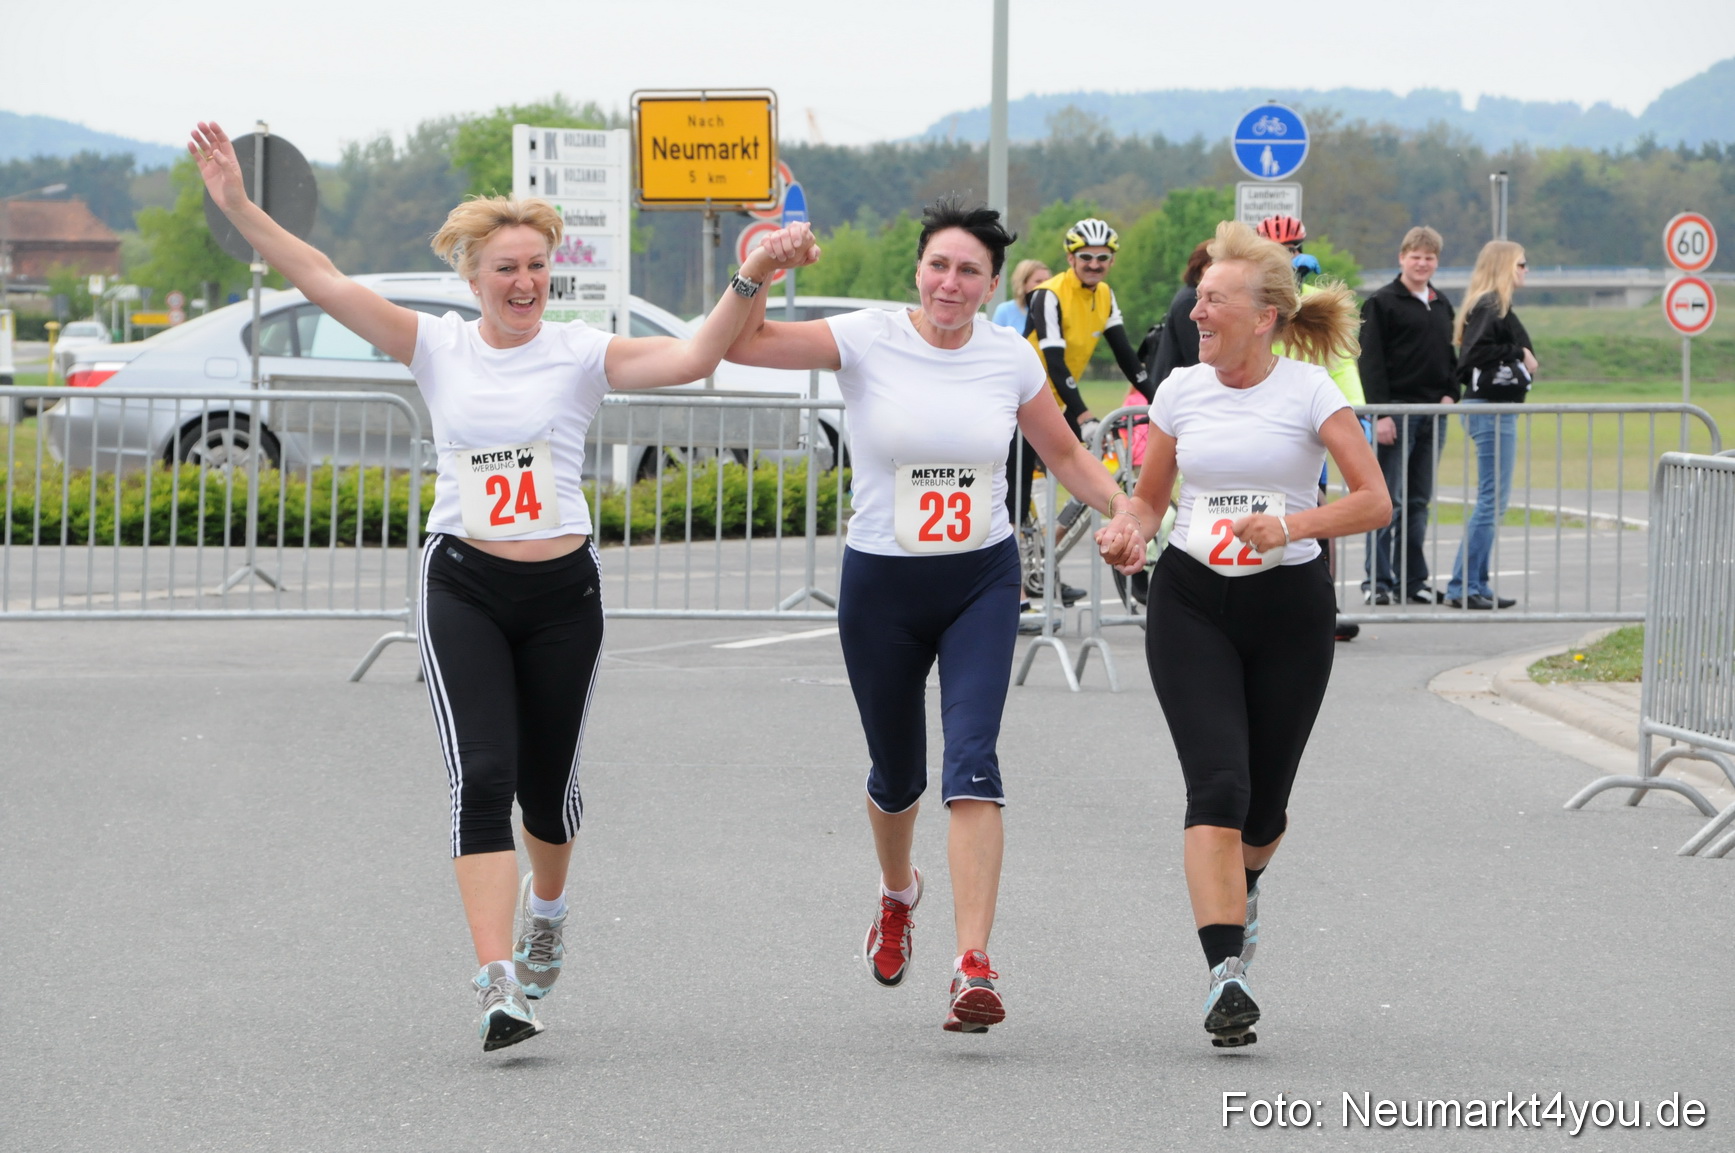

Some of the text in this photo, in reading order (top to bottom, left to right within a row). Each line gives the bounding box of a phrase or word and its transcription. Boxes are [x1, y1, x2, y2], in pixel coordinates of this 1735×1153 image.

[688, 115, 724, 127] Nach
[652, 136, 760, 160] Neumarkt
[689, 170, 727, 184] 5 km
[1244, 202, 1294, 210] schaftlicher
[1677, 231, 1704, 255] 60
[471, 451, 513, 465] MEYER
[472, 460, 516, 473] WERBUNG
[912, 469, 956, 479] MEYER
[912, 479, 956, 487] WERBUNG
[485, 470, 542, 527] 24
[1208, 495, 1249, 507] MEYER
[1208, 505, 1249, 515] WERBUNG
[918, 491, 971, 543] 23
